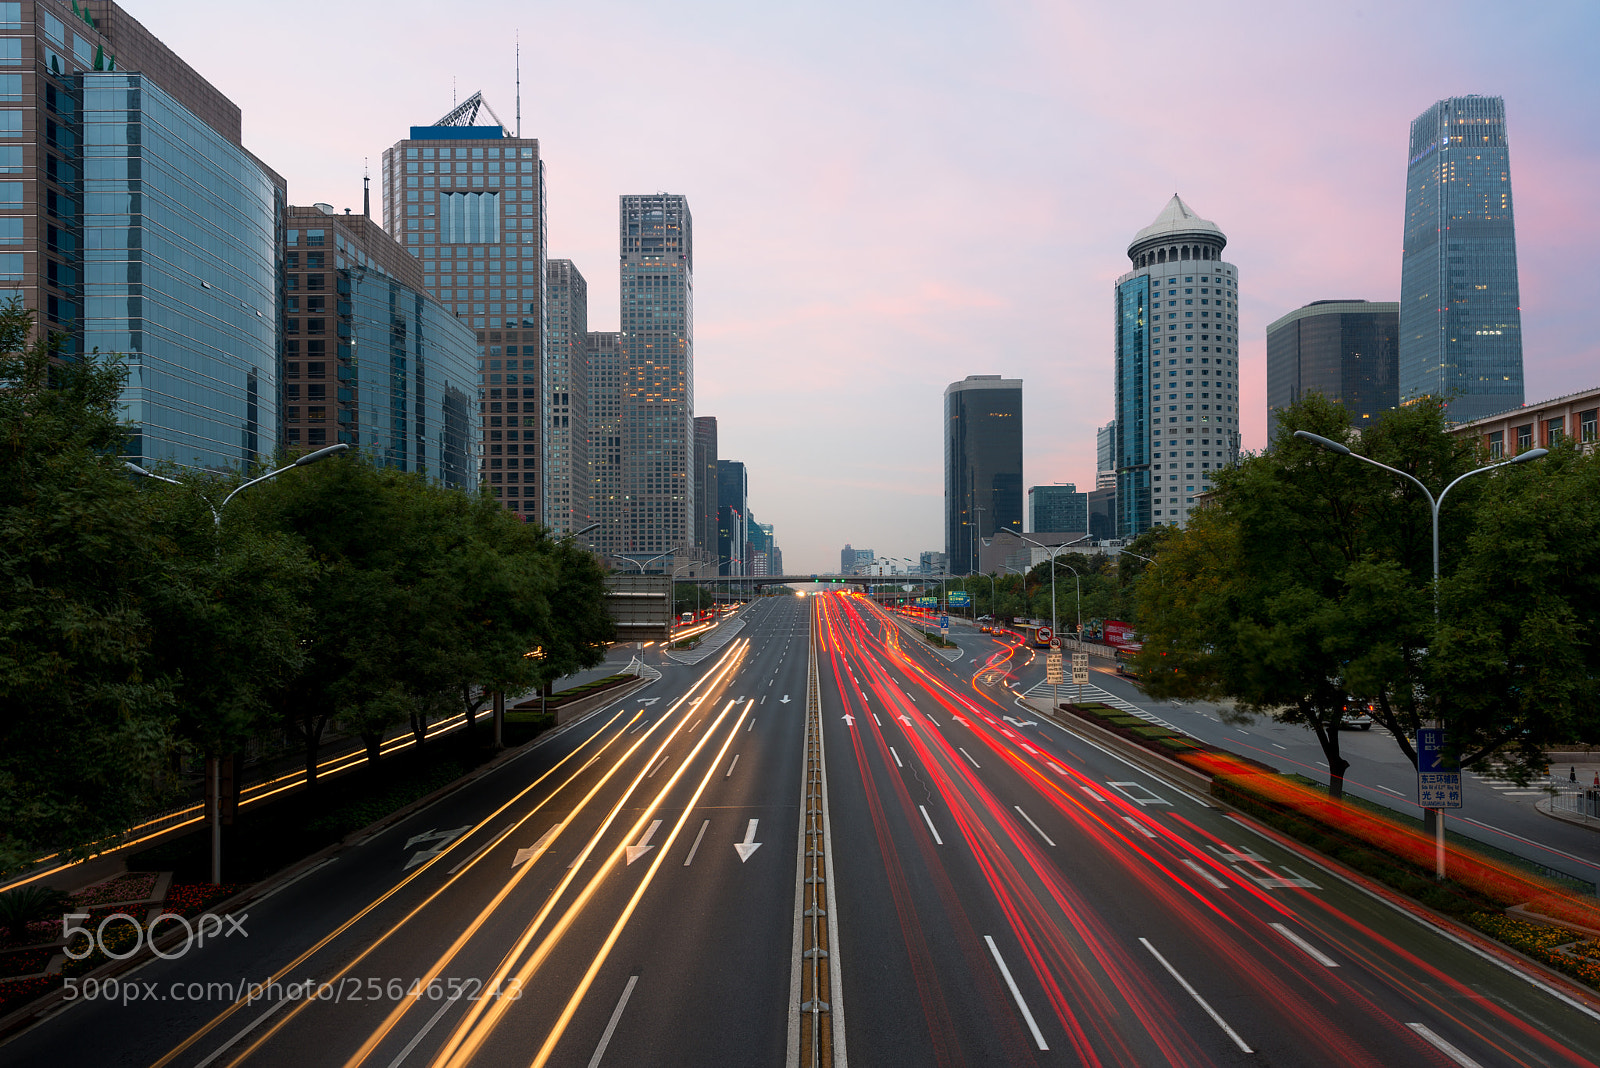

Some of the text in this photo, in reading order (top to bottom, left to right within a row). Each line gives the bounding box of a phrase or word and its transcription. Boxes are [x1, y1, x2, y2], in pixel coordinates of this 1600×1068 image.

[1421, 774, 1459, 784] 东三环辅路
[1422, 791, 1459, 801] 光华桥
